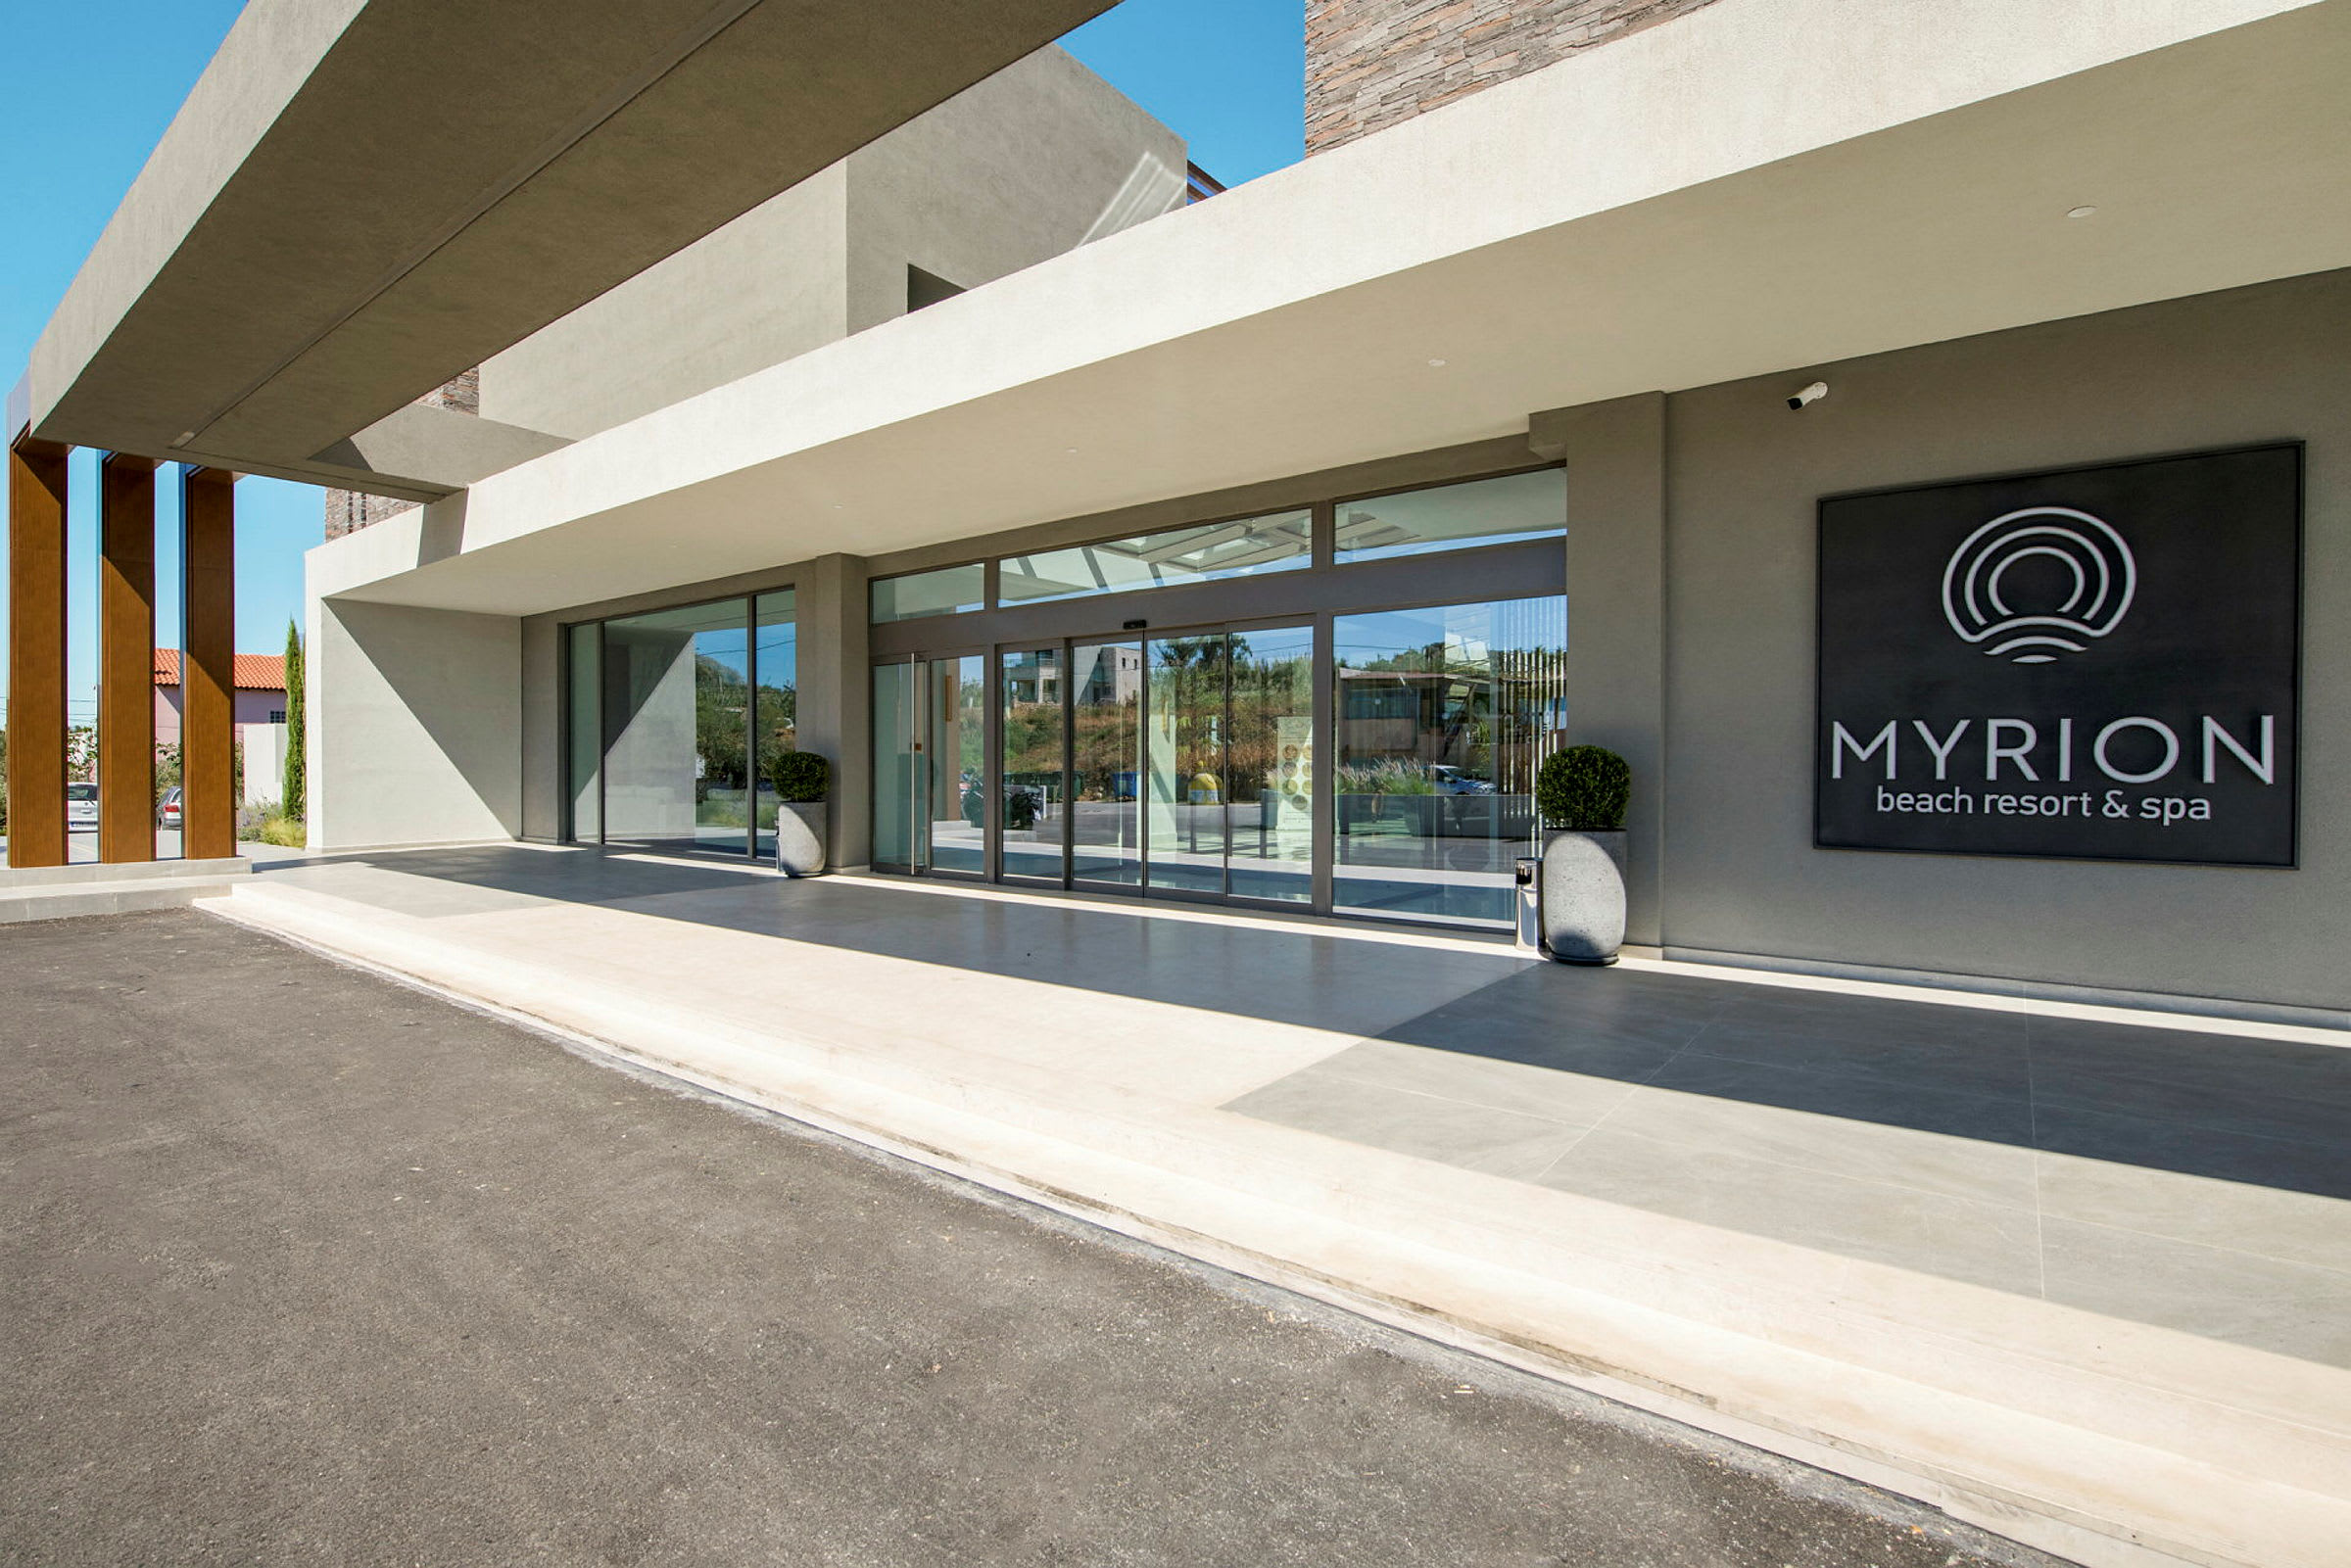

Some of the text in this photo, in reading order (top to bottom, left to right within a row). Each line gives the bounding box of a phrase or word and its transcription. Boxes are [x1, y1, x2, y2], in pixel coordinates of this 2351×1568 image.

[1832, 715, 2274, 784] MYRION
[1877, 785, 2211, 827] beach resort & spa
